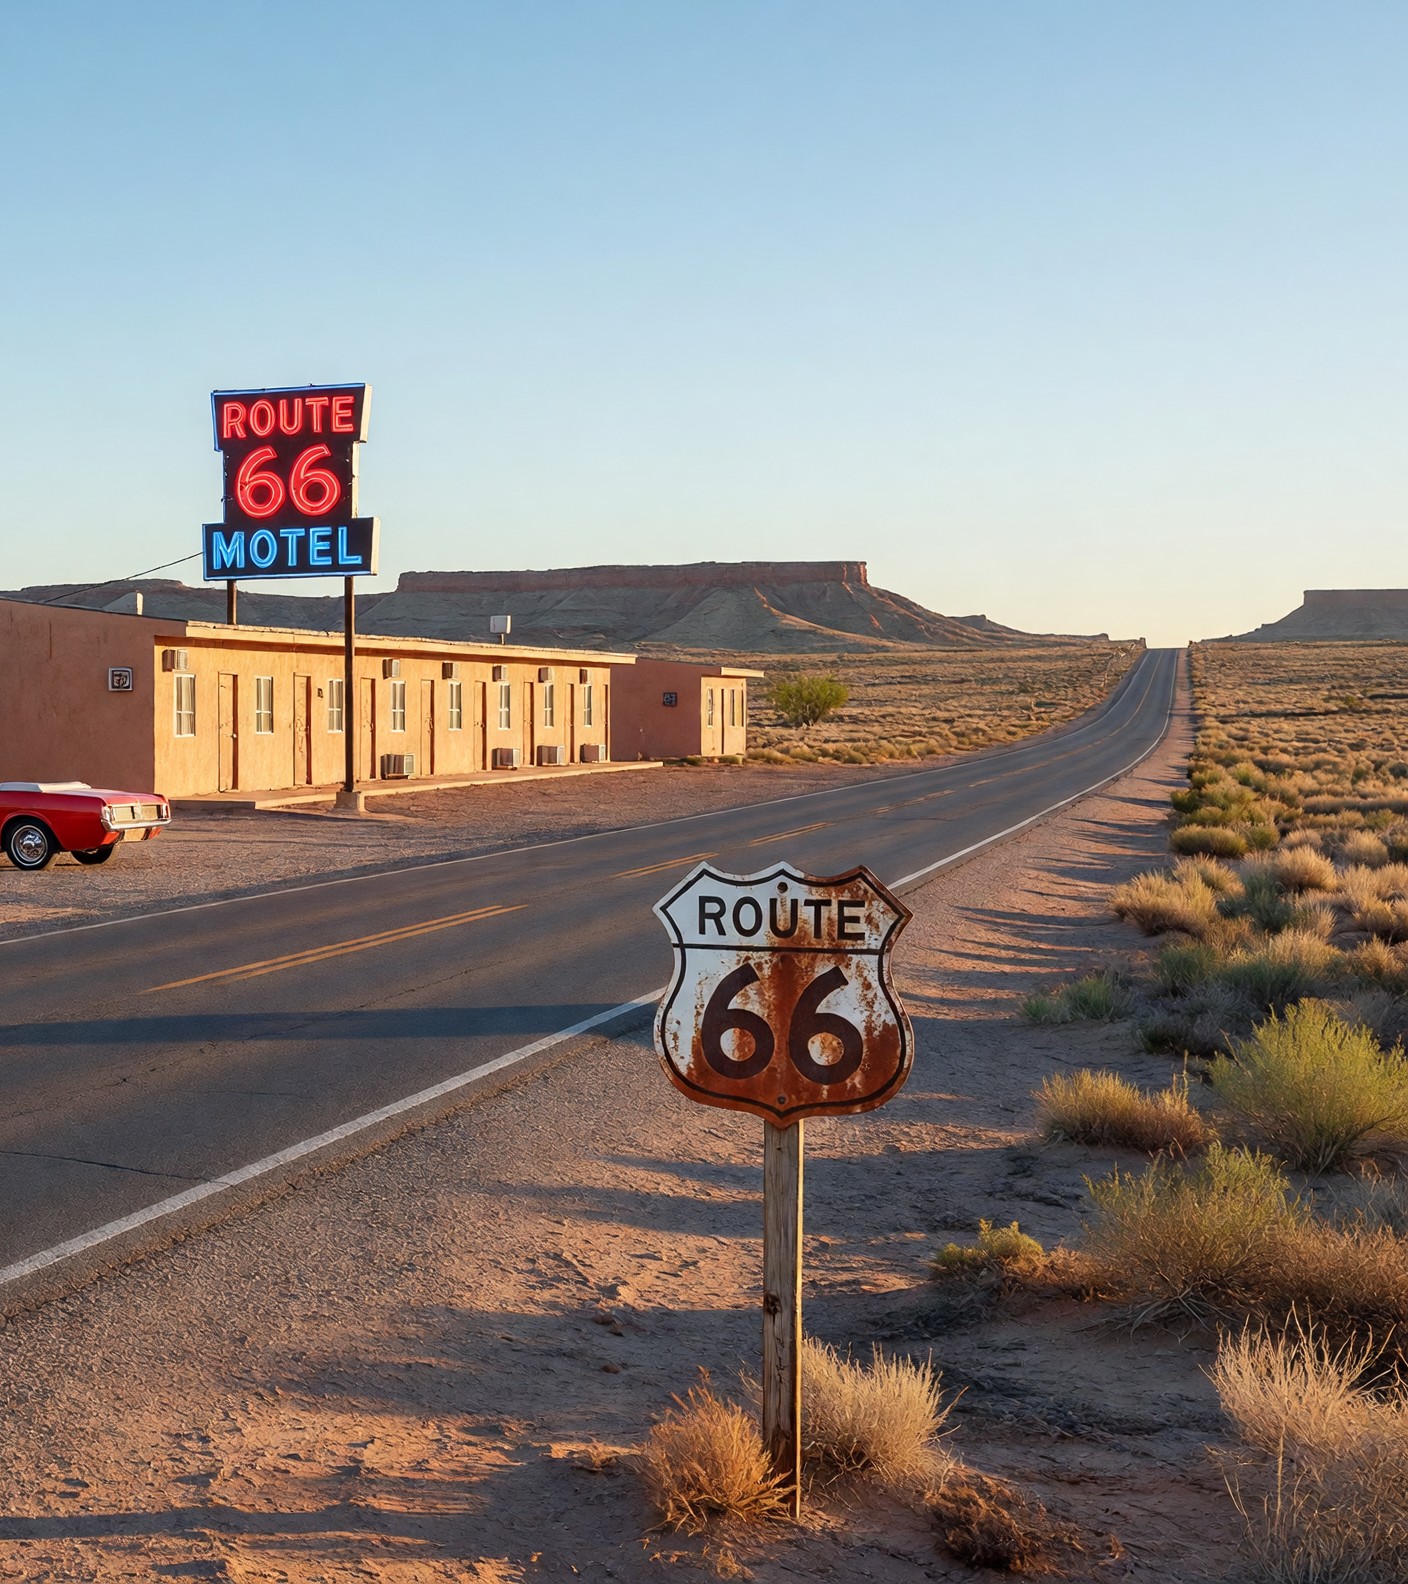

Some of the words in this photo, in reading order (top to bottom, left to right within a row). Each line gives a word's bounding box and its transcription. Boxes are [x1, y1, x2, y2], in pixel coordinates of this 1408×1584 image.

[222, 395, 355, 439] ROUTE
[235, 443, 341, 519] 66
[212, 526, 362, 570] MOTEL
[698, 895, 866, 941] ROUTE
[701, 962, 864, 1085] 66
